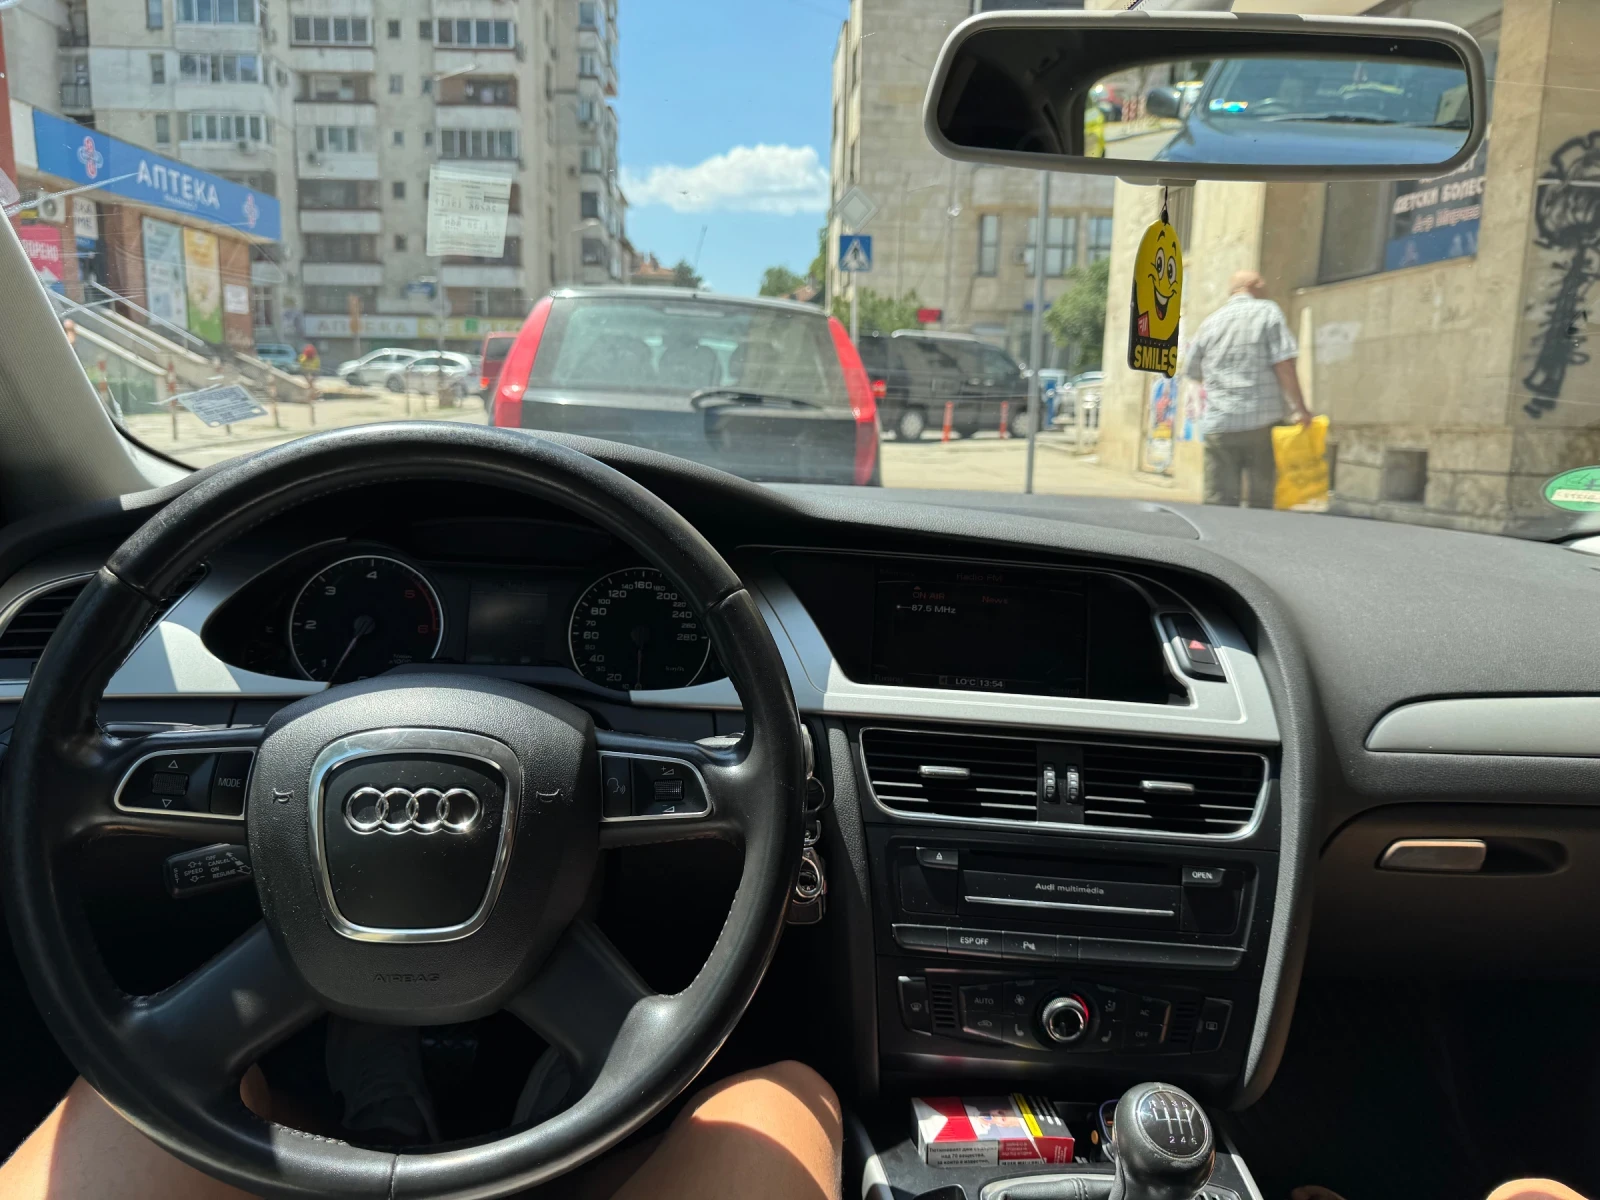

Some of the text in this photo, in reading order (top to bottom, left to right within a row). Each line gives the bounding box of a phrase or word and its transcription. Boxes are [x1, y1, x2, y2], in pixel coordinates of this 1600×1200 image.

[136, 159, 220, 210] АПТЕКА
[317, 319, 408, 333] АПЕКА
[1133, 344, 1177, 377] SMILES
[366, 570, 378, 580] 4
[956, 572, 1004, 584] Radio FM
[634, 581, 652, 589] 160
[324, 586, 337, 596] 3
[404, 590, 416, 599] 5
[608, 590, 627, 598] 120
[656, 592, 678, 600] 200
[912, 592, 946, 601] ON AIR
[982, 596, 1010, 605] News
[590, 607, 607, 616] 80
[672, 610, 692, 619] 240
[934, 605, 957, 615] MHz
[304, 620, 317, 630] 2
[583, 631, 600, 640] 60
[676, 633, 697, 642] 280
[590, 654, 605, 663] 40
[606, 674, 622, 682] 20
[979, 678, 1004, 689] 13:54
[218, 777, 242, 788] MODE
[207, 858, 230, 867] CANCEL
[183, 868, 204, 877] SPEED
[213, 868, 237, 879] RESUME
[1191, 871, 1214, 880] OPEN
[1035, 882, 1106, 895] Audi multimedia
[960, 936, 989, 946] ESP OFF
[372, 973, 441, 984] AIRBAG
[974, 997, 995, 1005] AUTO
[1135, 1031, 1149, 1039] OFF
[1168, 1135, 1176, 1145] 2
